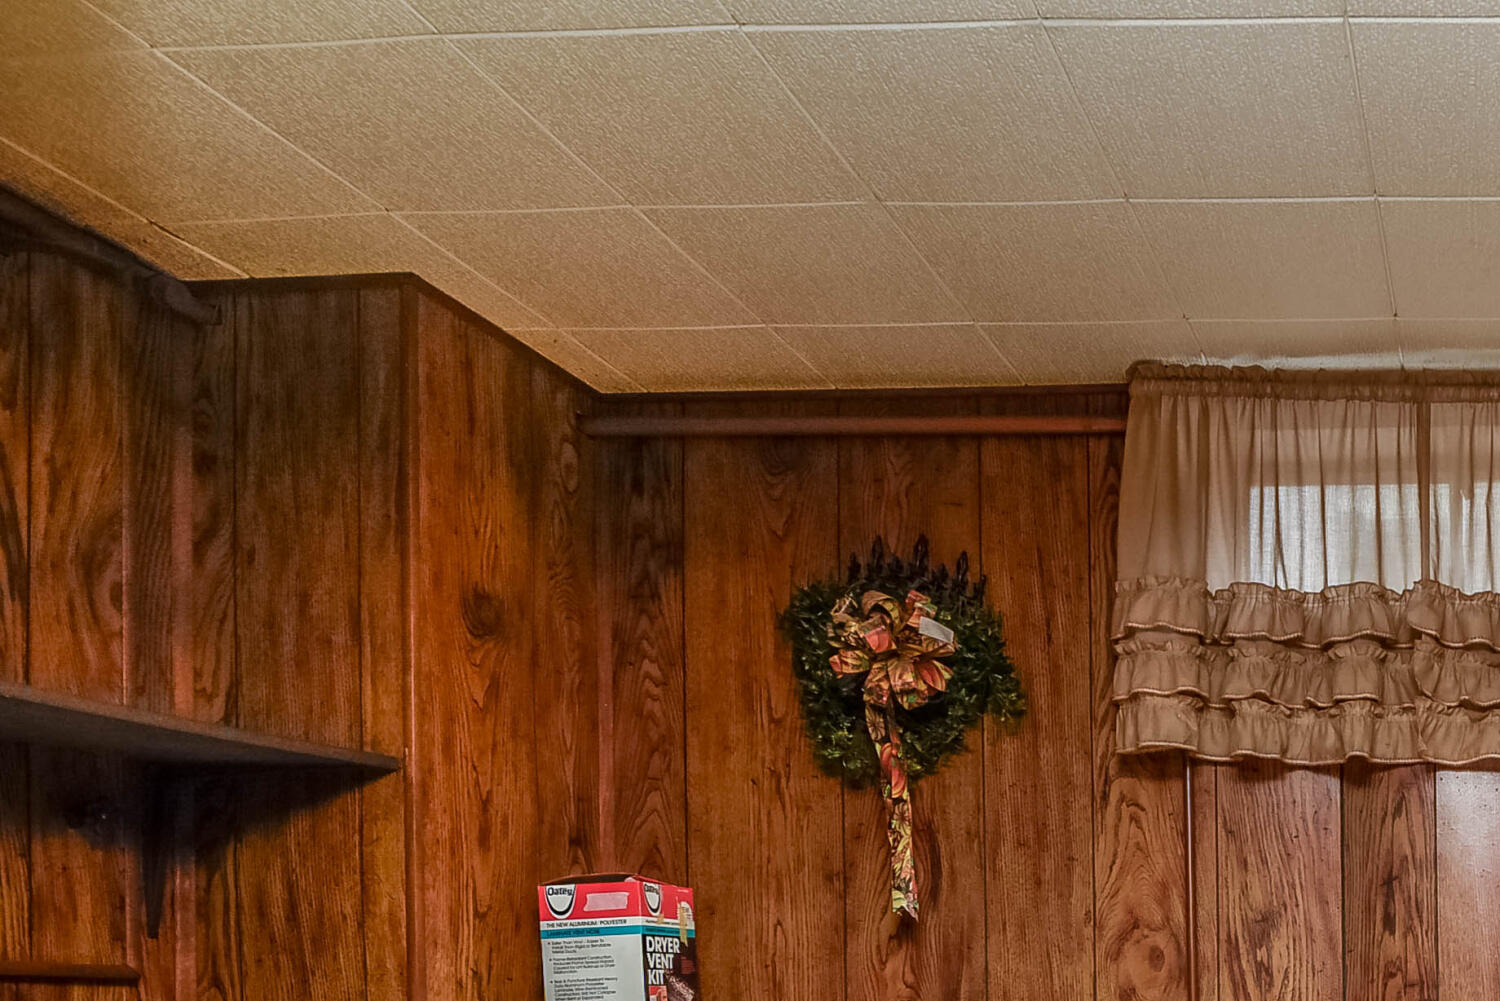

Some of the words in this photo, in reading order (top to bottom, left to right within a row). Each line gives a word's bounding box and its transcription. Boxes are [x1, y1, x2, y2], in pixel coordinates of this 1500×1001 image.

[646, 935, 681, 954] DRYER
[646, 952, 675, 970] VENT
[647, 968, 666, 986] KIT
